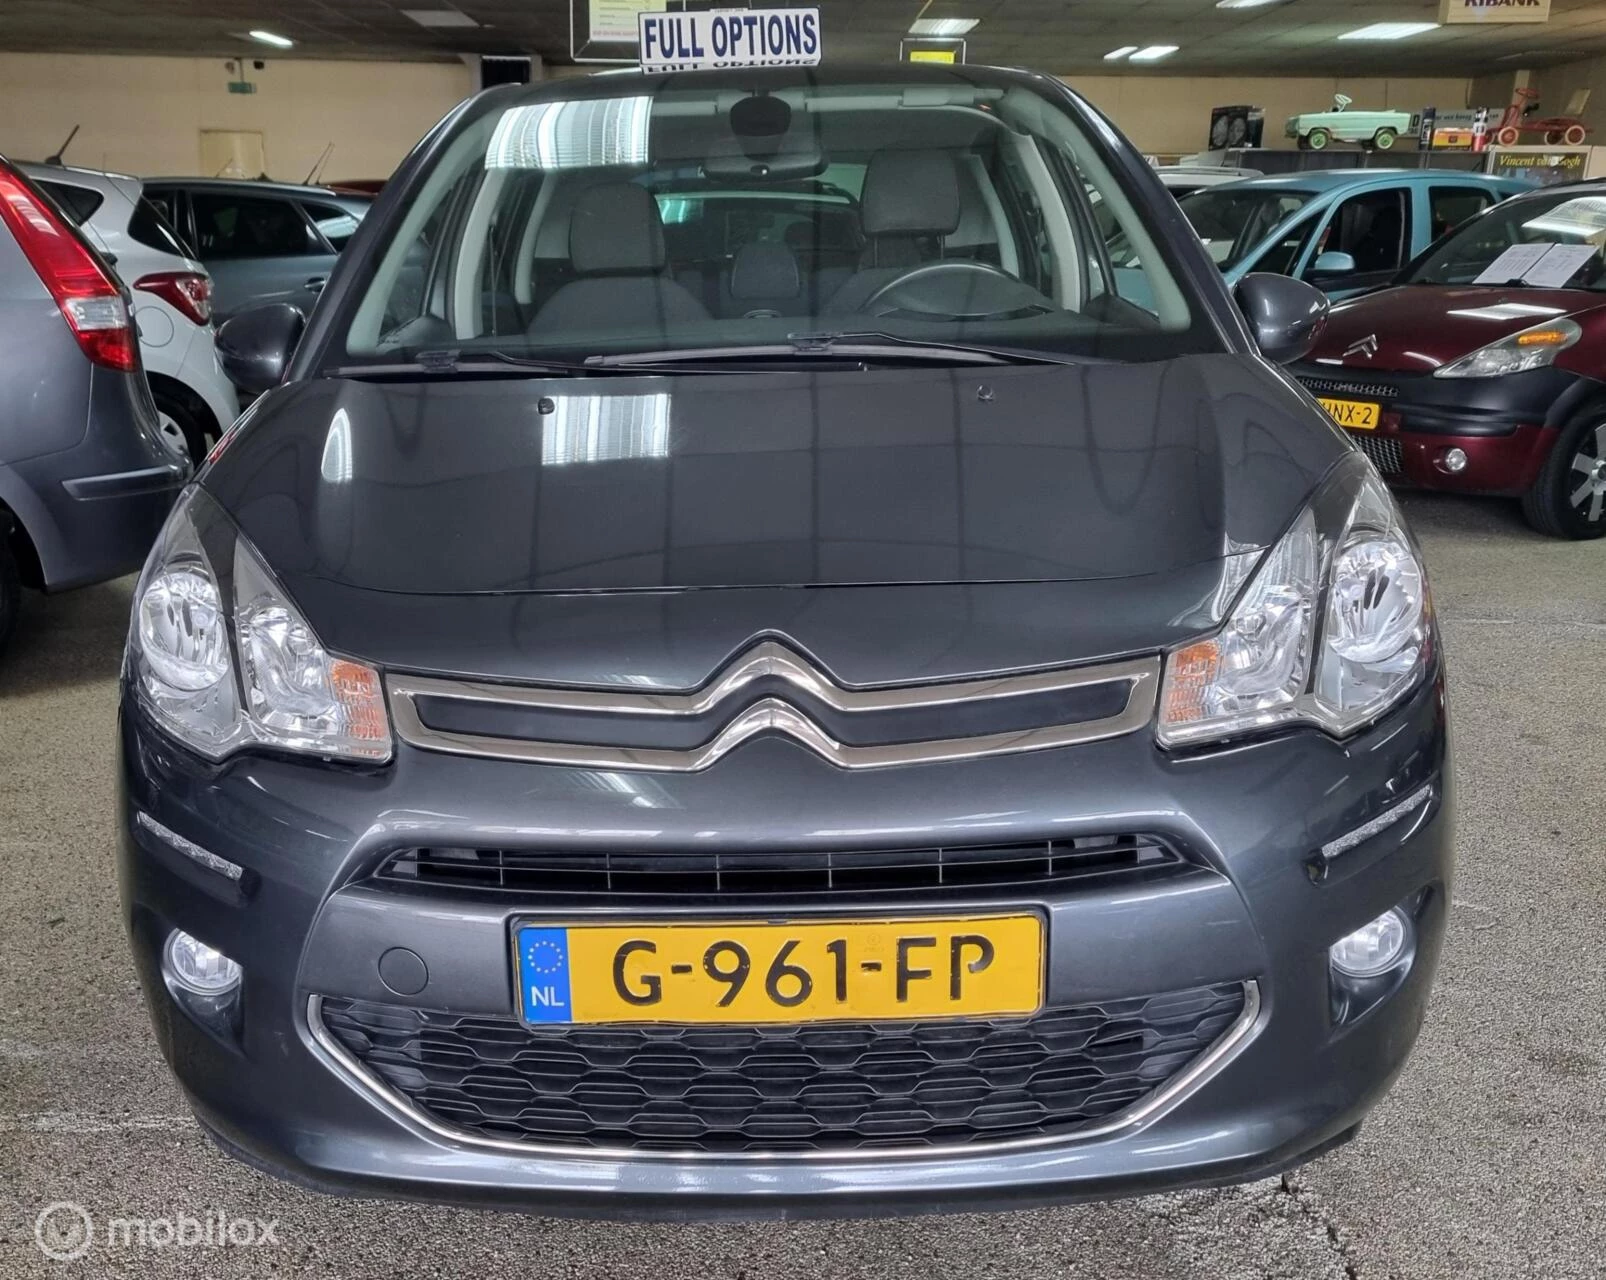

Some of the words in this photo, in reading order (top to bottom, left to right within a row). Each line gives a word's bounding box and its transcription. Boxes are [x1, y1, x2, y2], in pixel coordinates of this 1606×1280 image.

[644, 17, 704, 59] FULL
[711, 14, 817, 57] OPTIONS
[1500, 154, 1535, 166] Vincent
[531, 986, 565, 1007] NL
[612, 934, 995, 1008] G-961-FP
